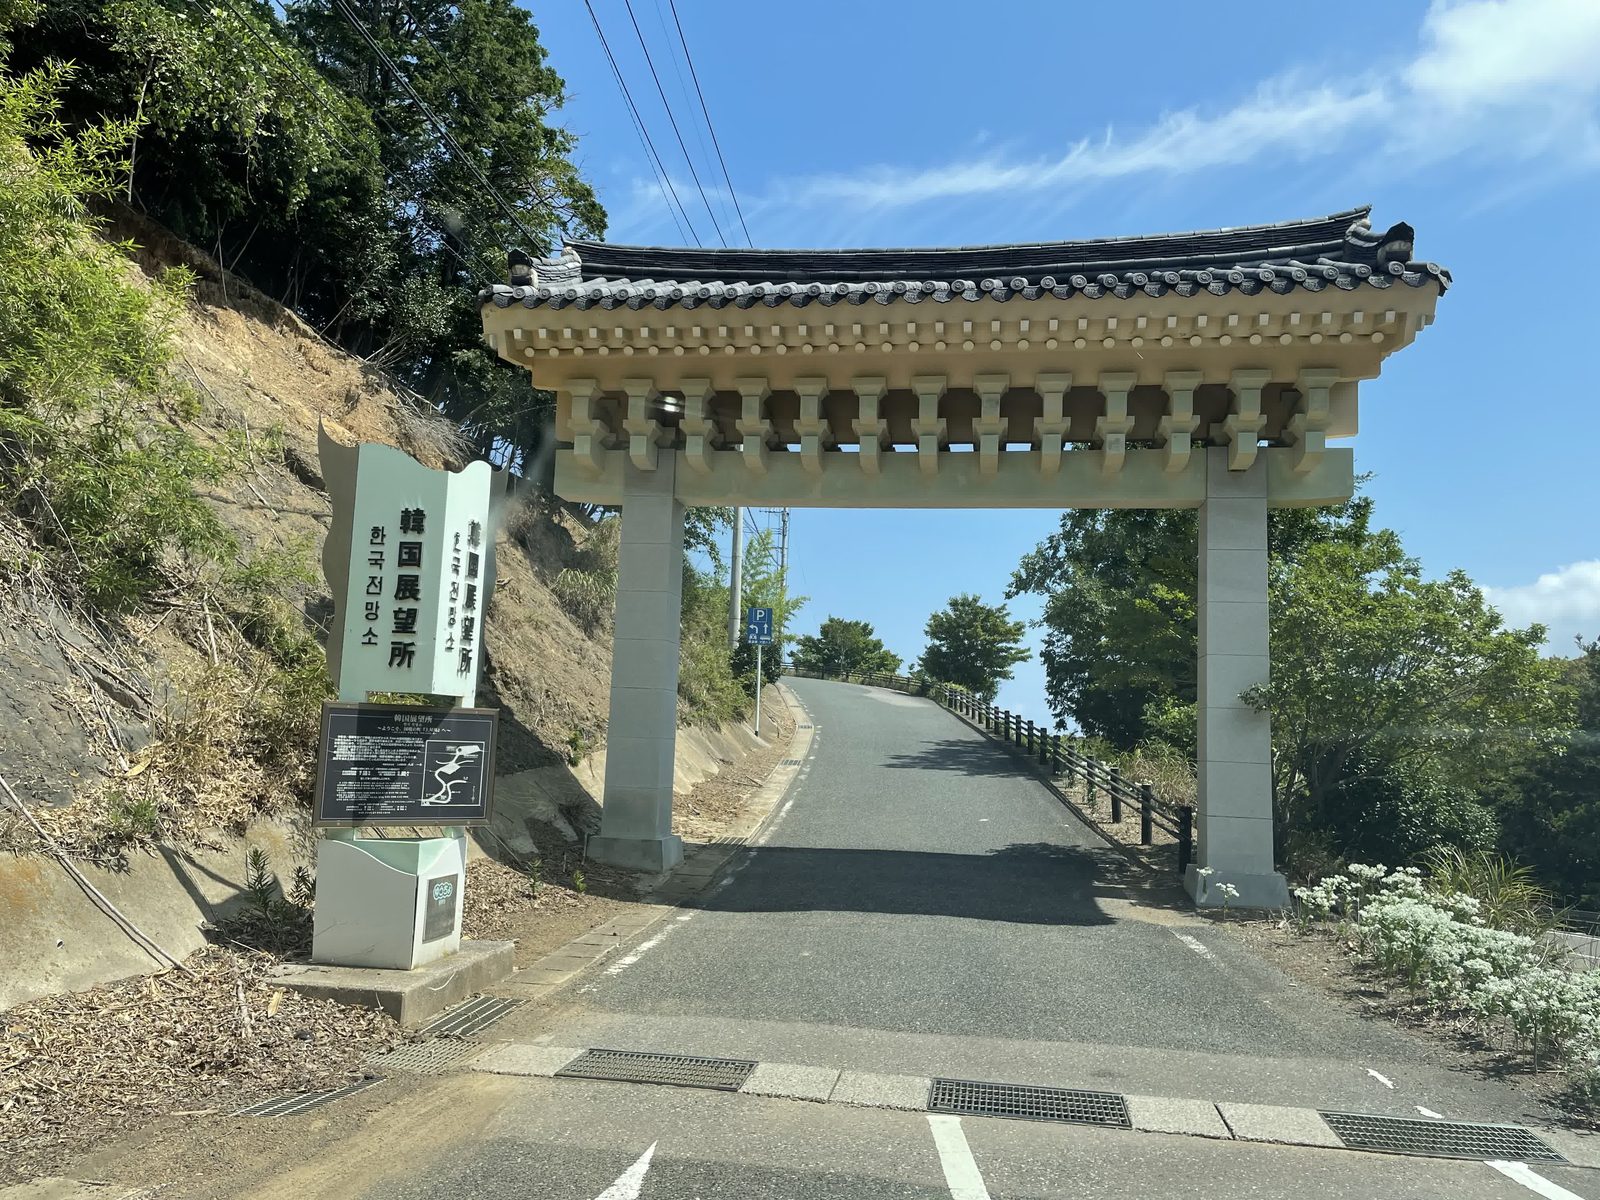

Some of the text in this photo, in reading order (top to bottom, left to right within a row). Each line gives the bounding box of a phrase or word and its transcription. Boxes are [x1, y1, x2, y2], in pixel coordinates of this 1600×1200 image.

[361, 525, 387, 646] 한국전망소
[388, 506, 426, 669] 韓国展望所
[756, 610, 764, 620] P
